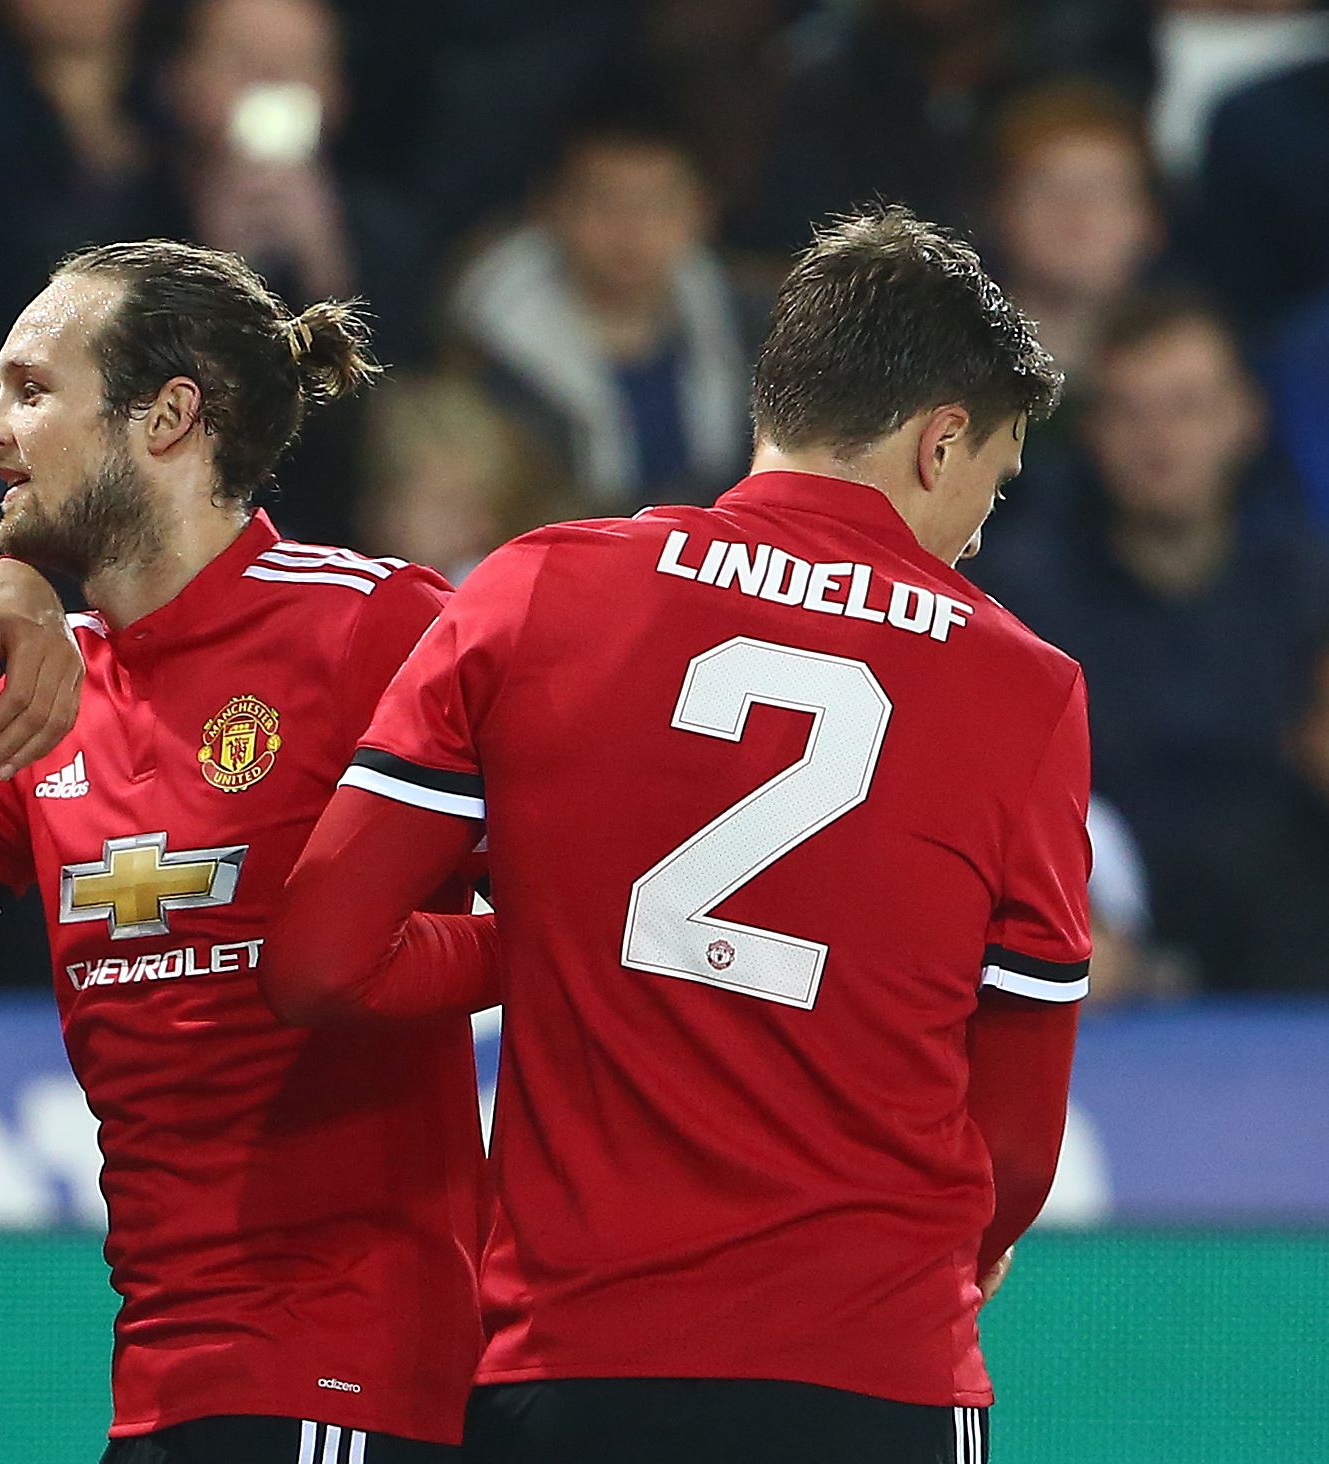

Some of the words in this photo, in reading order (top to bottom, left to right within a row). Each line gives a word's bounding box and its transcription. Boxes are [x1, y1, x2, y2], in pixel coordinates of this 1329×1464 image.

[656, 530, 974, 642] LINDELOF
[209, 702, 274, 738] MANCHESTER
[213, 766, 262, 785] UNITED
[621, 636, 893, 1010] 2
[66, 938, 264, 992] CHEVROLET
[318, 1378, 361, 1393] adizero
